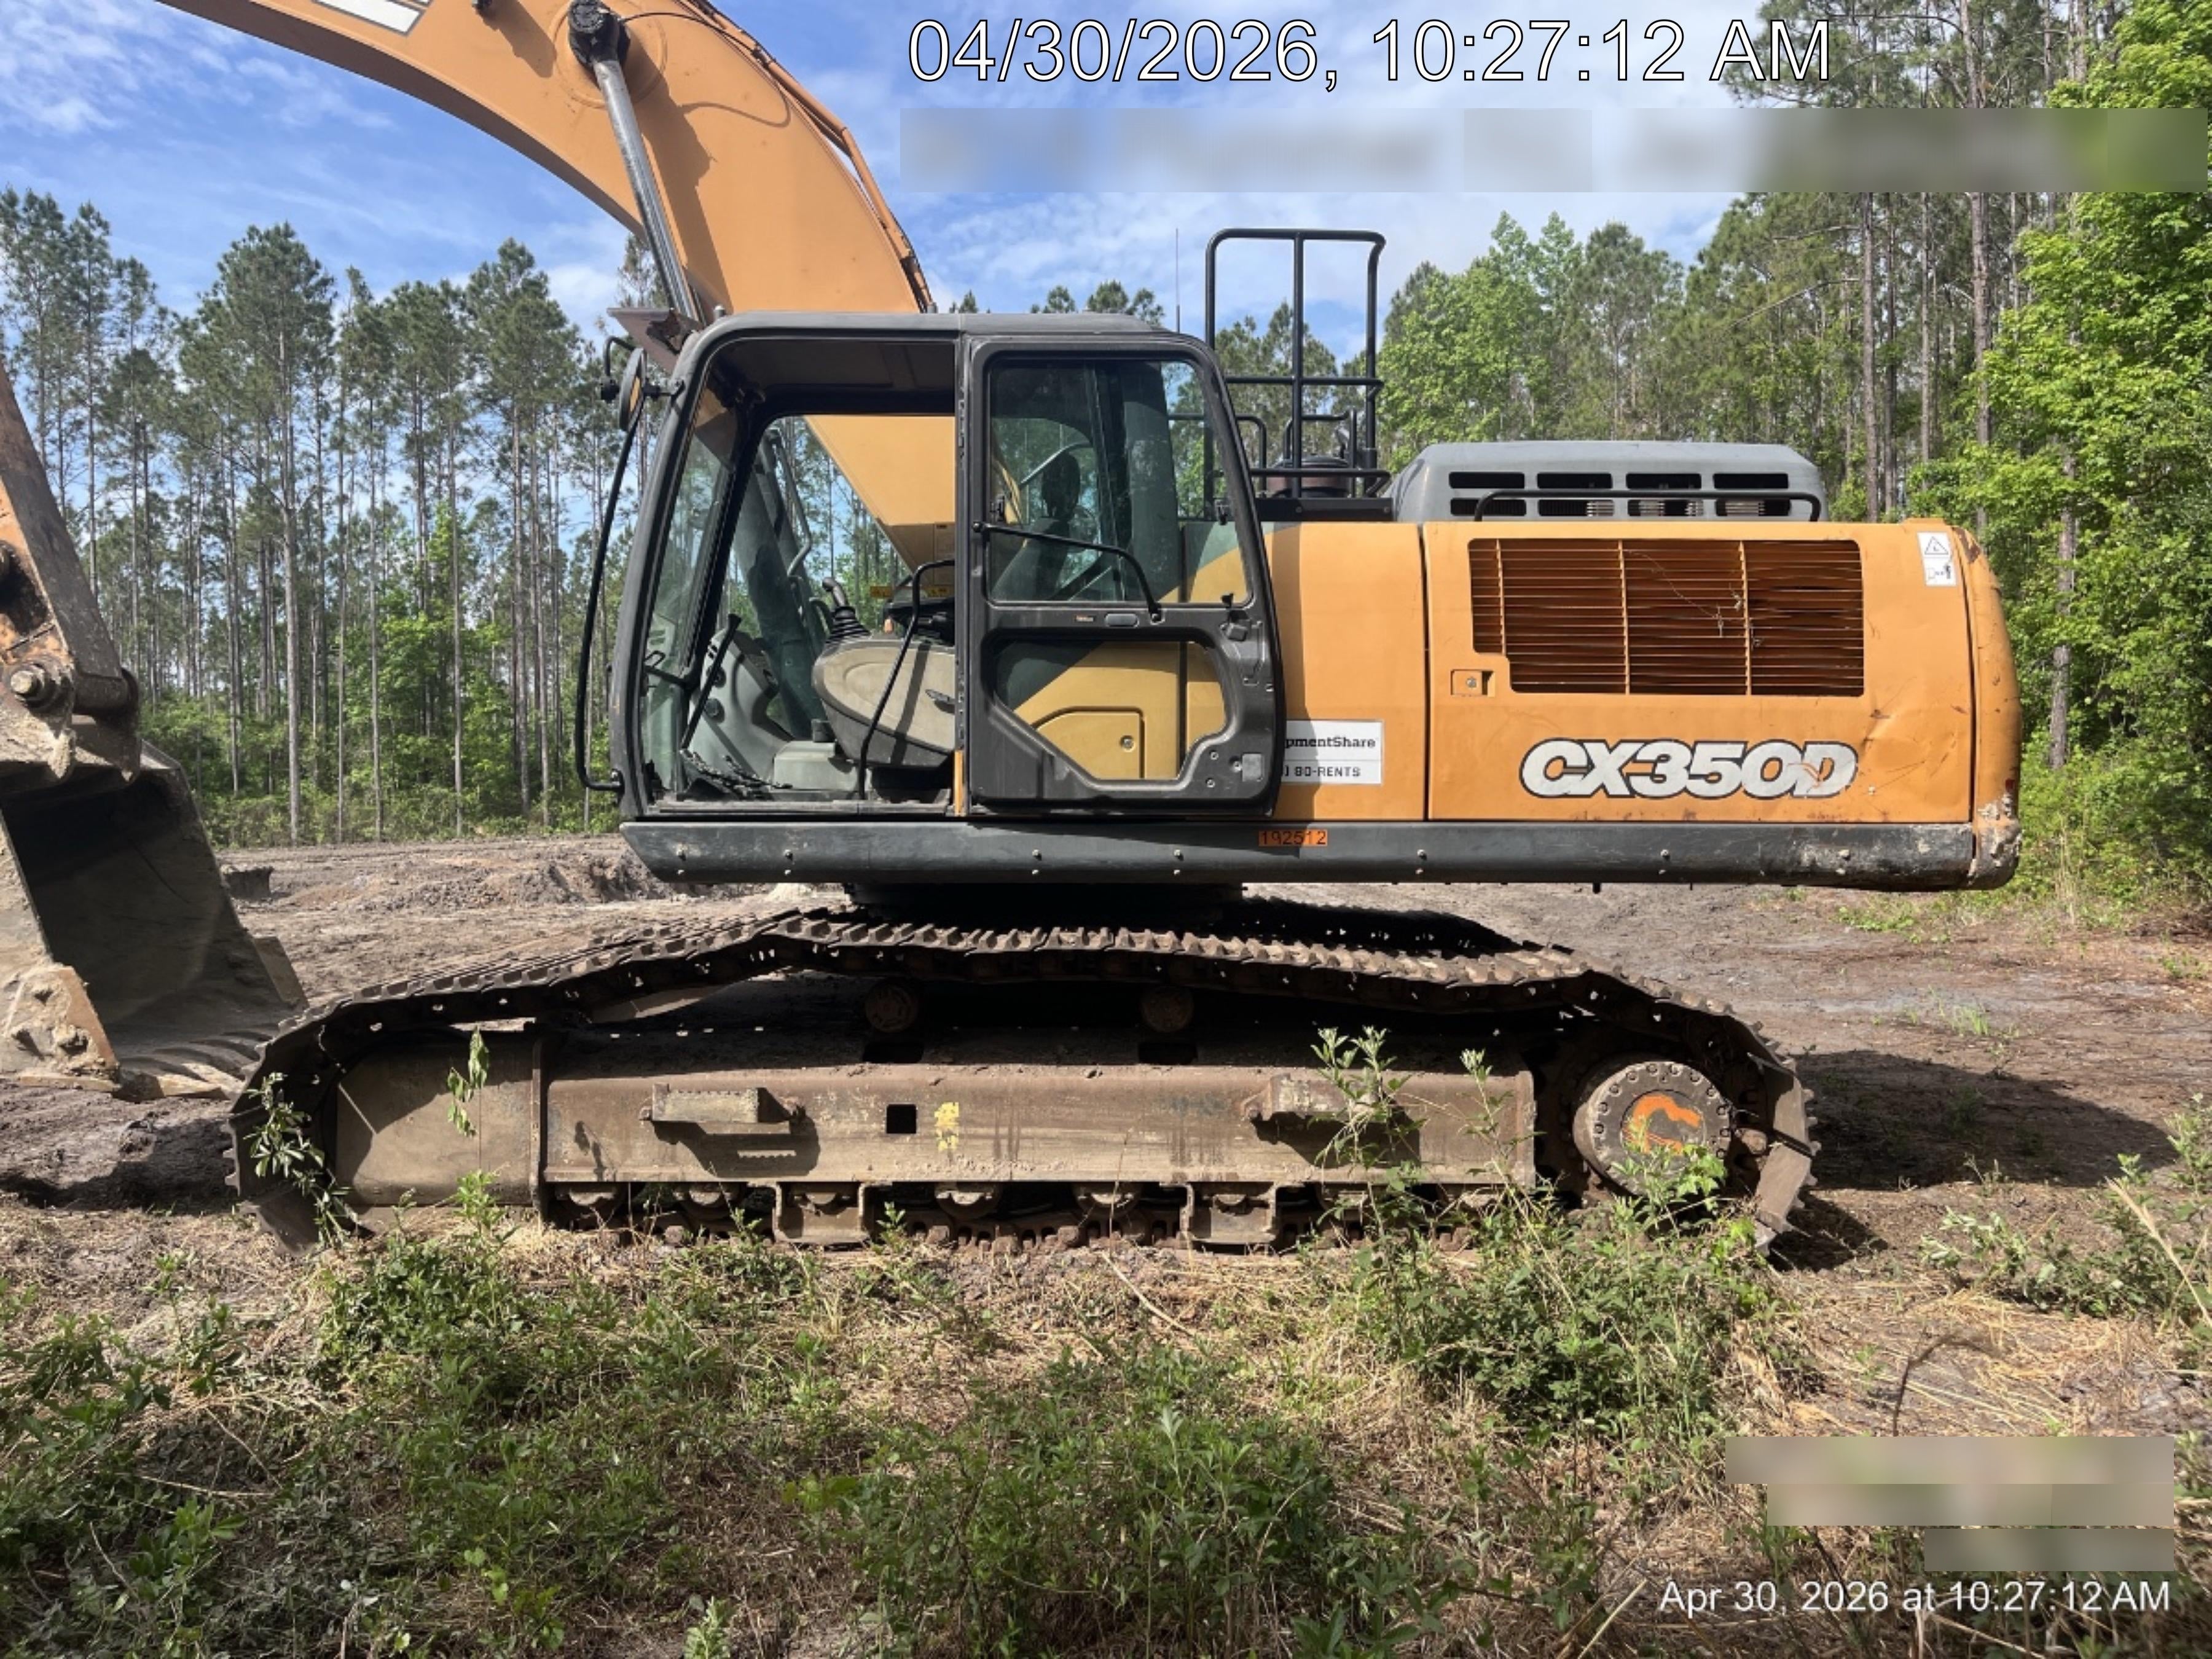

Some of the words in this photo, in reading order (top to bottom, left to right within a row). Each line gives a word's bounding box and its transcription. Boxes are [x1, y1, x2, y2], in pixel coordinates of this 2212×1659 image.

[1285, 736, 1376, 749] pmentShare
[1519, 739, 1858, 799] CX350D
[1262, 830, 1326, 845] 192512
